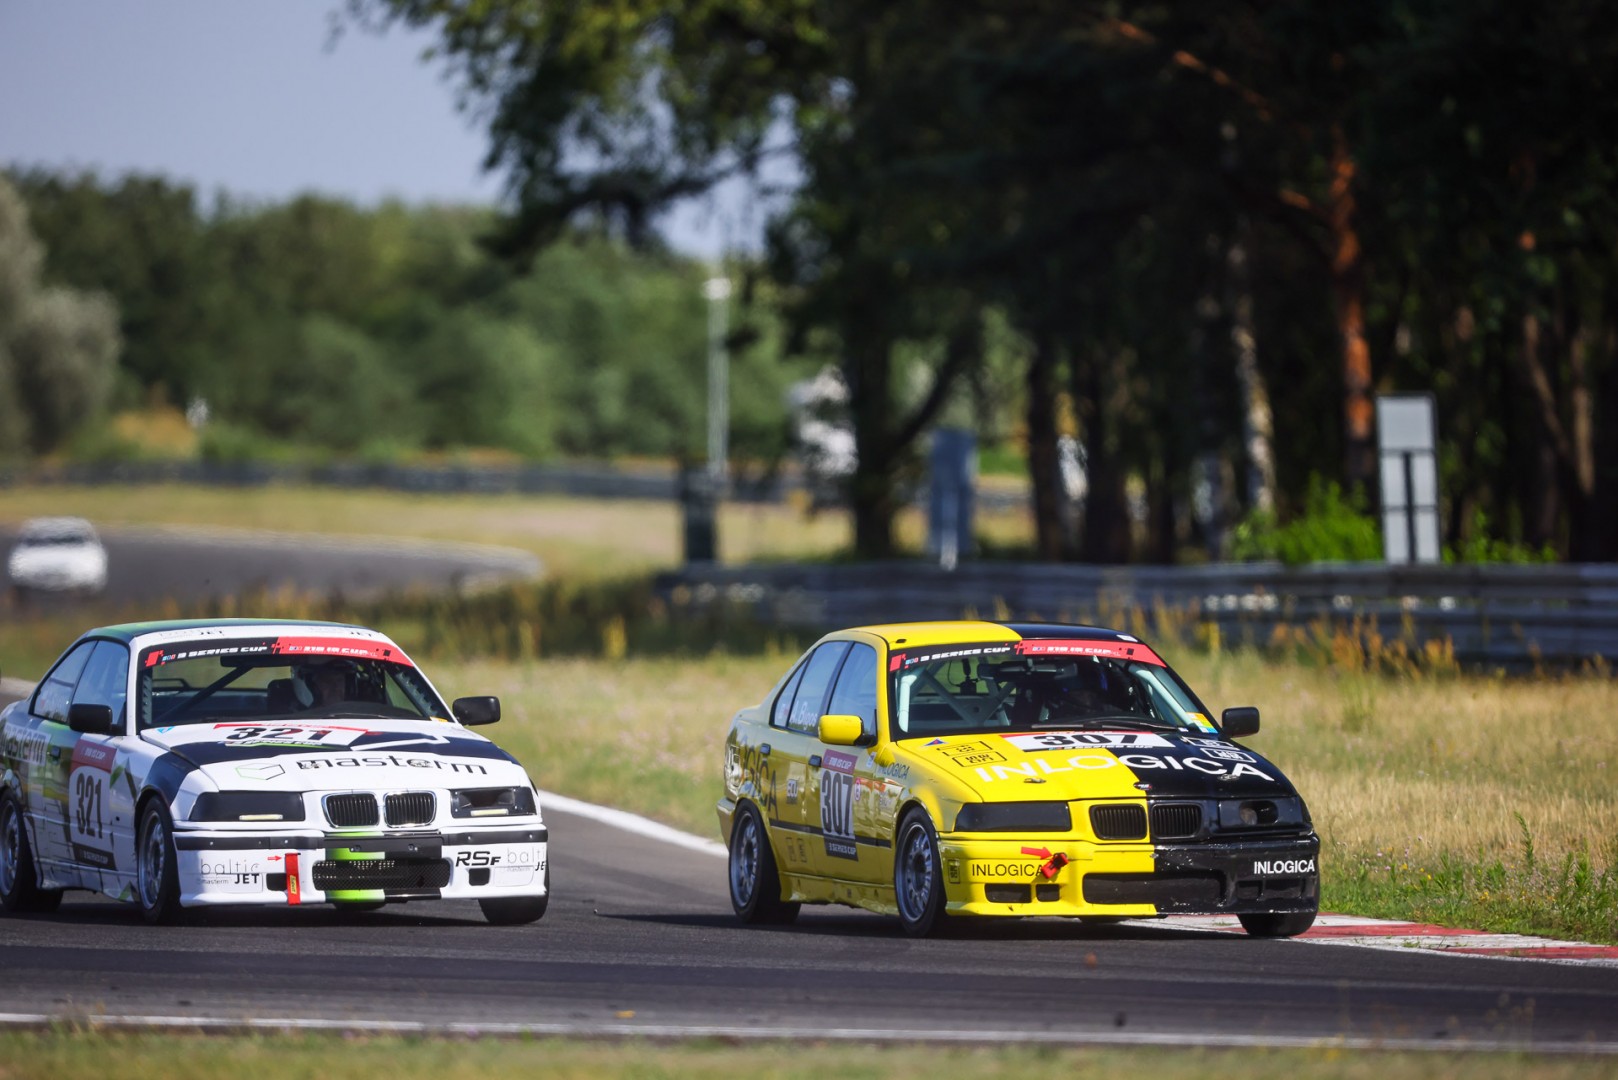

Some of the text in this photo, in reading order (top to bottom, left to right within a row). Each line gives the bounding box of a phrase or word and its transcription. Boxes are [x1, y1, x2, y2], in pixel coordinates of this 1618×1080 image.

[188, 647, 239, 658] SERIES
[341, 647, 368, 655] CUP
[931, 648, 982, 660] SERIES
[983, 646, 1011, 654] CUP
[226, 727, 332, 740] 321
[1033, 733, 1138, 746] 307
[296, 755, 488, 775] masterm
[975, 754, 1275, 782] INLOGICA
[76, 773, 103, 839] 321
[821, 770, 853, 837] 307
[200, 859, 260, 875] baltic
[1253, 859, 1316, 875] INLOGICA
[234, 873, 260, 884] JET
